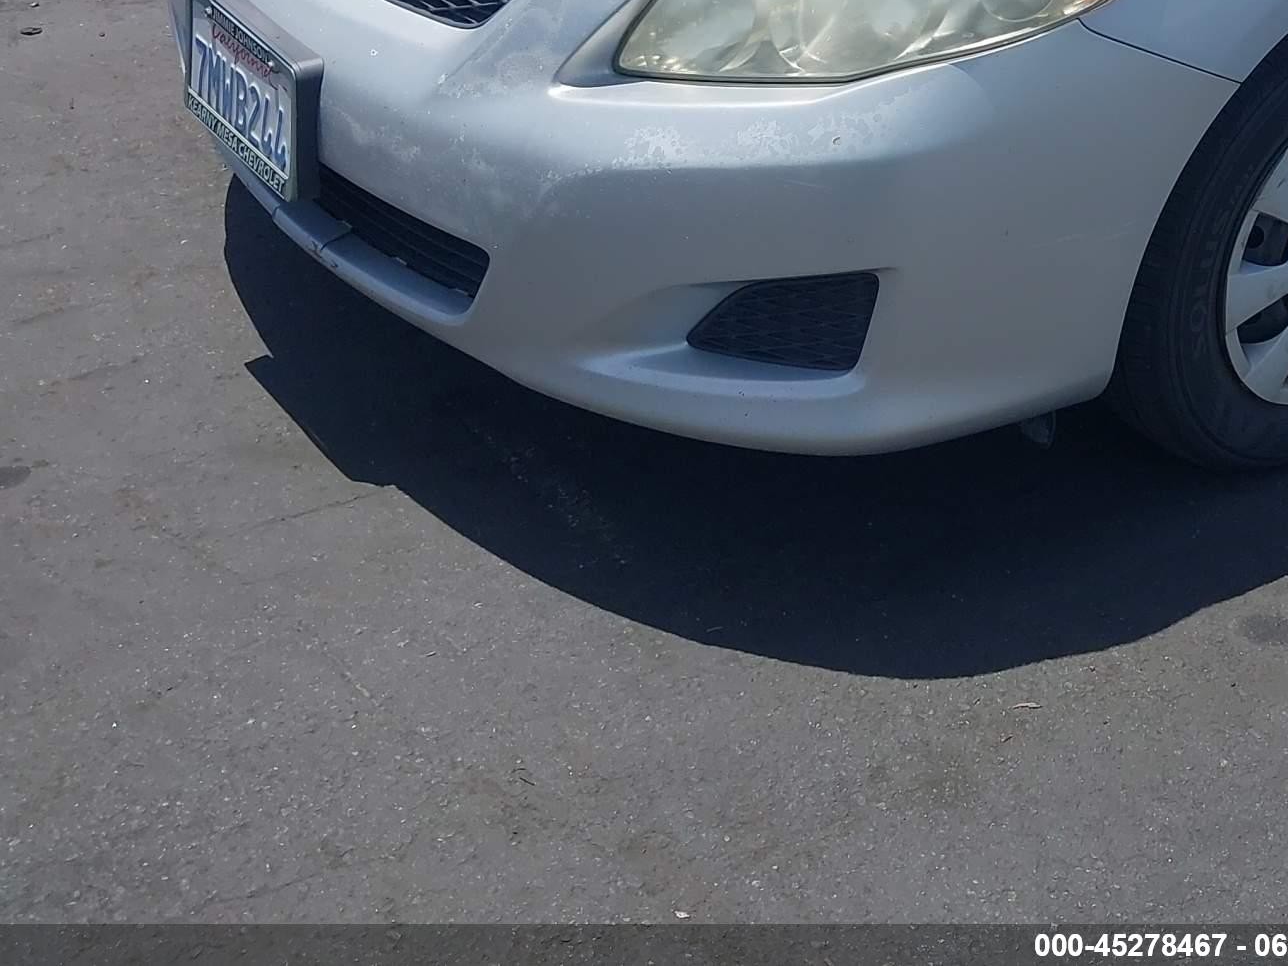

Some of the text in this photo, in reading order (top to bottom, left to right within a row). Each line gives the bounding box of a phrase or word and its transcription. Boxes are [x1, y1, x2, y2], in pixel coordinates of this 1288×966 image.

[213, 8, 235, 36] JIMMIE
[188, 94, 285, 192] KEARNY MESA CHEVROLET
[195, 36, 289, 173] 7MWB244
